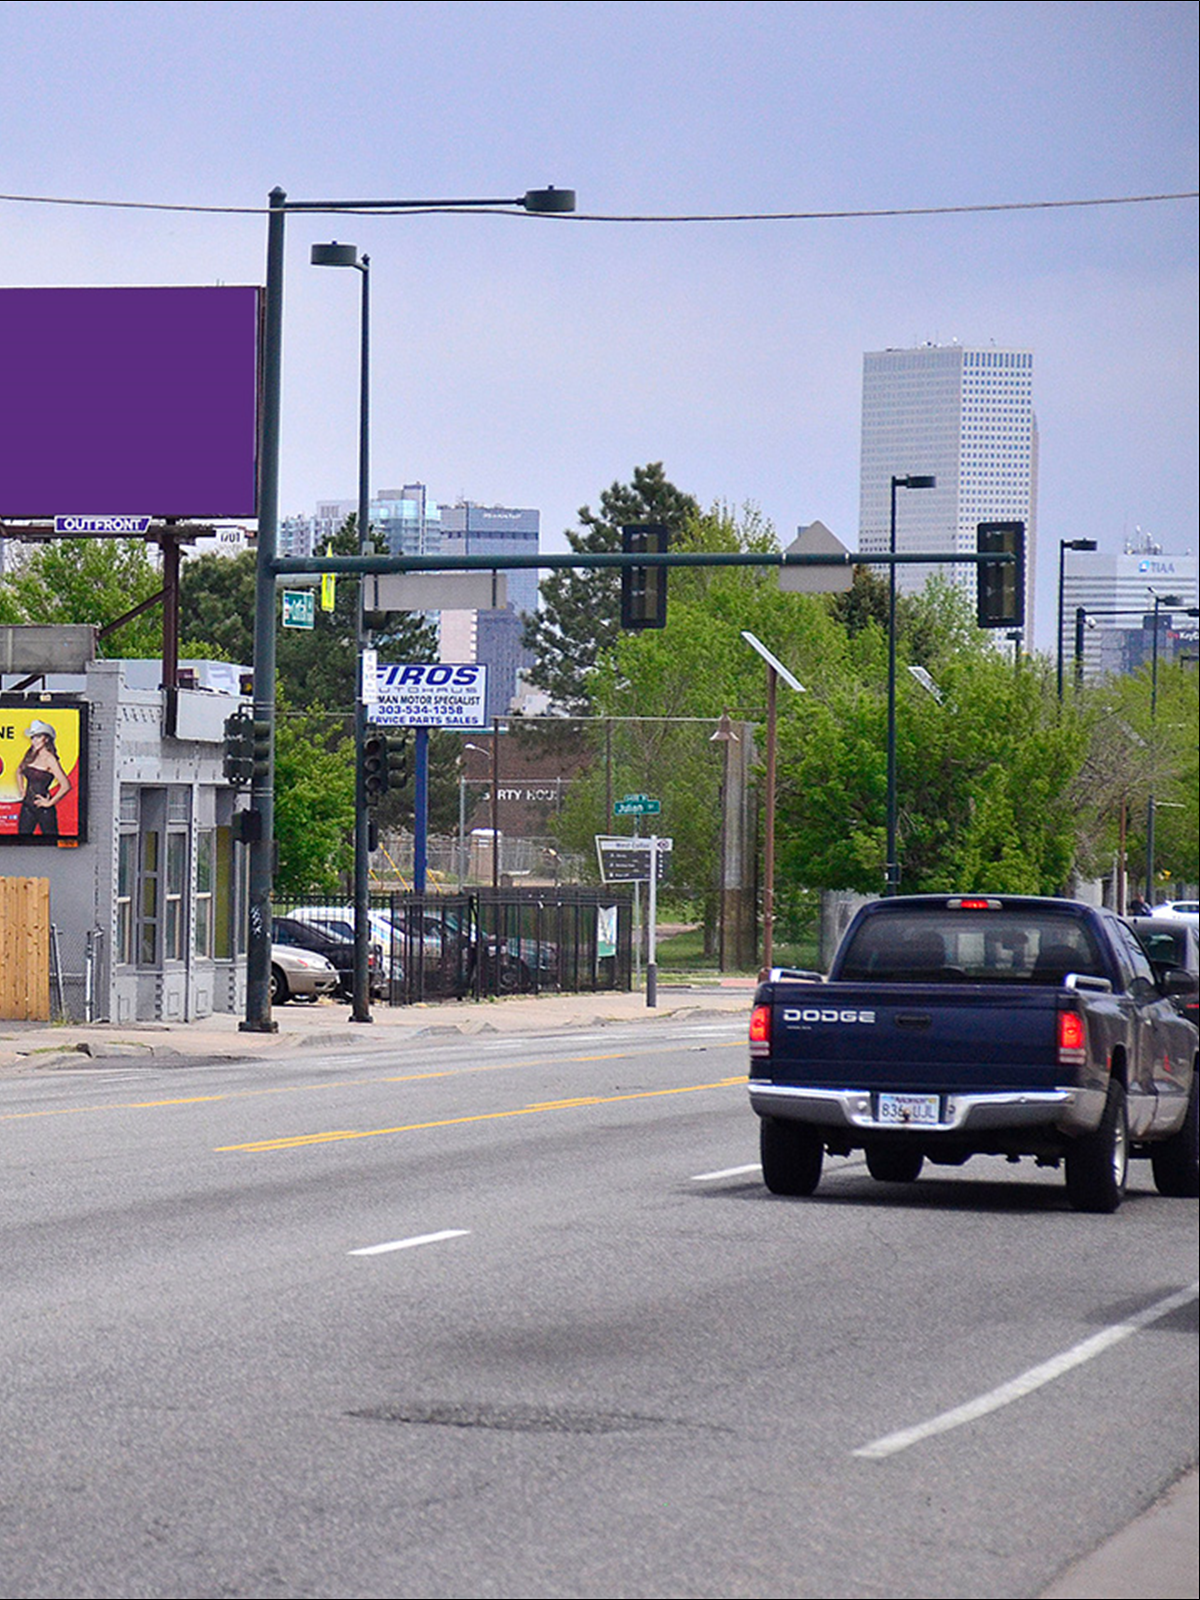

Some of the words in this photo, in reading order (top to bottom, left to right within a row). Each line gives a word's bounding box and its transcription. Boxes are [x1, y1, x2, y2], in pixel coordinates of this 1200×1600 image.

[63, 518, 141, 530] OUTFRONT
[378, 686, 478, 694] UTOHAUS
[400, 695, 432, 704] MOTOR
[434, 696, 481, 705] SPECIALIST
[378, 705, 463, 715] 303-534-1358
[369, 715, 405, 724] ERVICE
[409, 716, 442, 724] PARTS
[446, 716, 479, 724] SALES
[783, 1009, 875, 1023] DODGE
